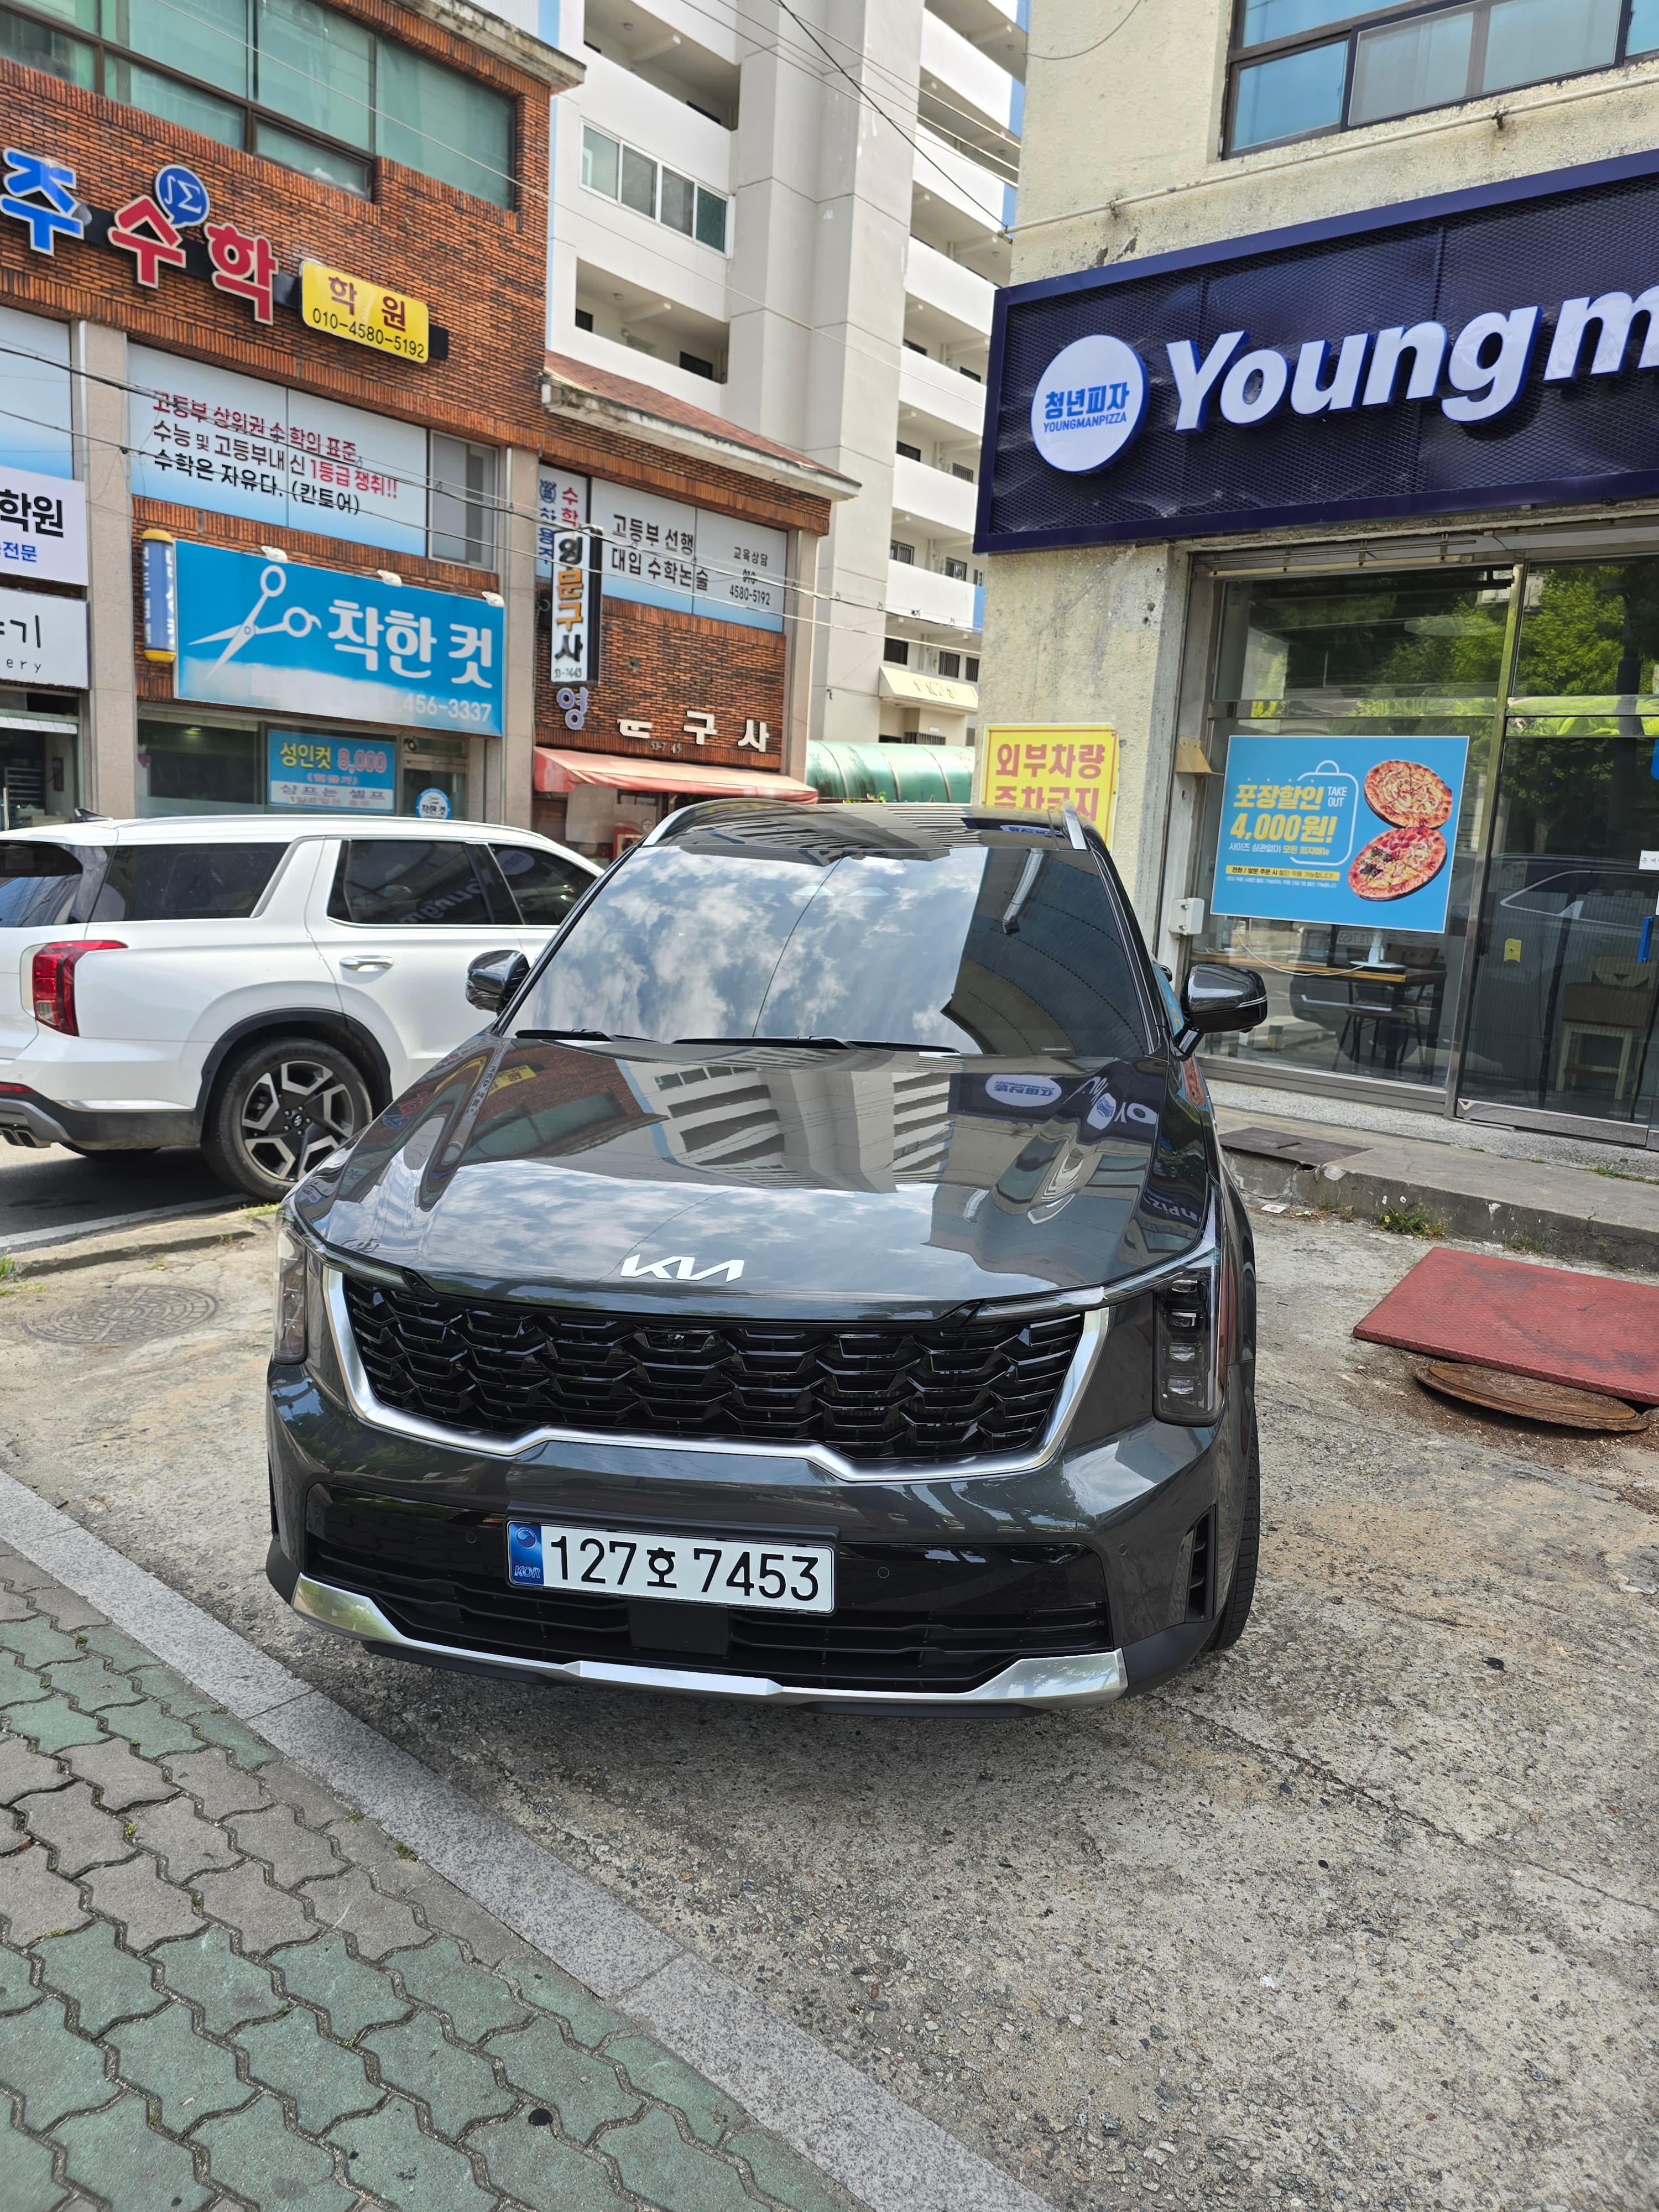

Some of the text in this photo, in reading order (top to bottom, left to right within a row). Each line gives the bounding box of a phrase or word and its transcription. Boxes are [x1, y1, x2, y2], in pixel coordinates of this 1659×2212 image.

[1, 148, 84, 256] 주
[312, 307, 425, 359] 010-4580-5192
[153, 390, 207, 422] 고등부
[1045, 382, 1129, 420] 청년피자
[1044, 411, 1126, 433] YOUNGMANPIZZA
[154, 420, 190, 447] 수능
[196, 434, 209, 452] 및
[310, 458, 350, 487] 1등급
[355, 469, 398, 499] 쟁취!!
[154, 449, 213, 481] 수학은
[221, 463, 283, 497] 자유다.
[612, 514, 693, 555] 고등부 선행
[0, 541, 37, 562] 전문
[733, 546, 768, 567] 교육상담
[612, 547, 709, 591] 대입 수학논술
[729, 584, 770, 606] 4580-5192
[327, 599, 493, 688] 착한 컷
[279, 742, 387, 774] 성인컷 8,000
[1234, 784, 1324, 810] 포장할인
[1328, 786, 1348, 797] TAKE
[1328, 797, 1344, 807] OUT
[1230, 813, 1337, 843] 4,000원!
[1229, 842, 1250, 852] 사이즈
[1252, 843, 1281, 853] 상관없이
[620, 1254, 744, 1282] KIA
[514, 1565, 541, 1578] KOR
